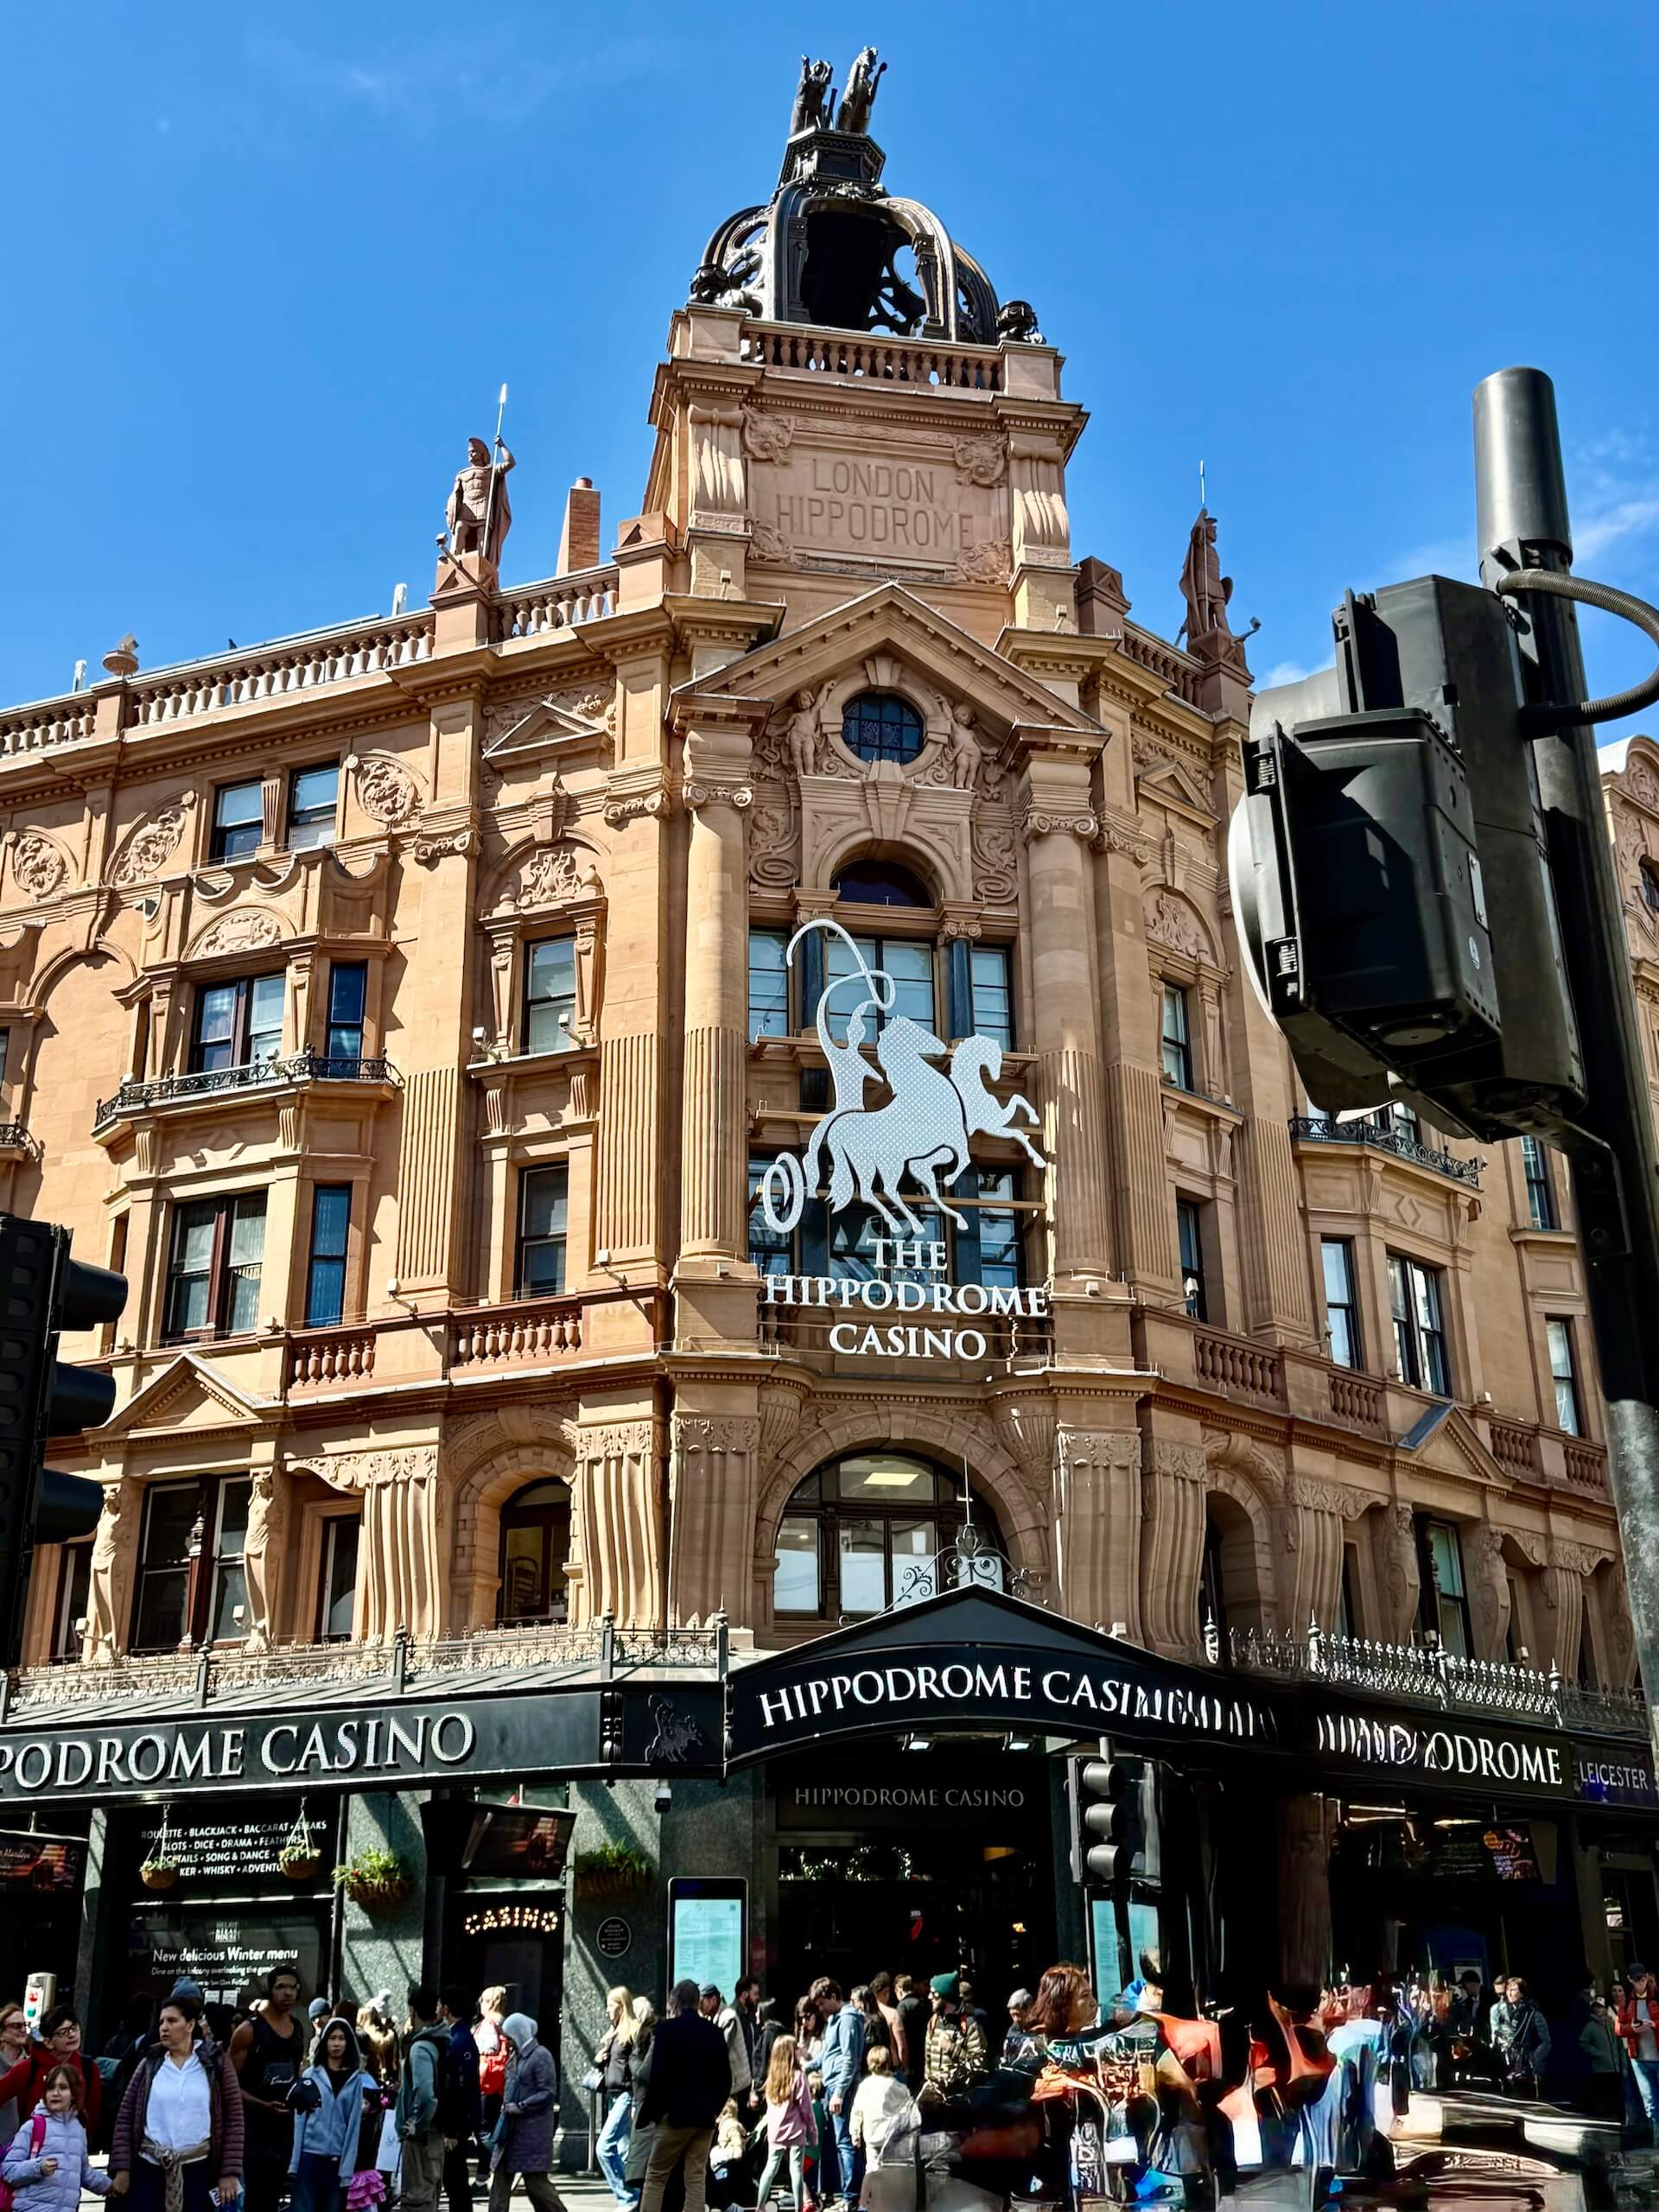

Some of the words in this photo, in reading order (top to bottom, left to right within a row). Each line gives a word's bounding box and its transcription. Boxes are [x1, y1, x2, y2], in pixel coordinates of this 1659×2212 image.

[812, 458, 935, 504] LONDON
[776, 494, 974, 550] HIPPODROME
[866, 1237, 948, 1271] THE
[763, 1274, 1048, 1318] HIPPODROME
[829, 1323, 987, 1361] CASINO
[758, 1664, 1032, 1727] HIPPODROME
[261, 1713, 475, 1775] CASINO
[1579, 1760, 1649, 1790] LEICESTER
[795, 1788, 940, 1806] HIPPODROME
[945, 1789, 1025, 1808] CASINO
[189, 1825, 238, 1838] BLACKJACK
[245, 1821, 289, 1834] BACCARAT
[194, 1840, 214, 1850] DICE
[221, 1838, 252, 1849] DRAMA
[203, 1865, 235, 1876] WHISKY
[206, 1853, 231, 1863] SONG
[232, 1851, 238, 1861] &
[239, 1850, 270, 1860] DANCE
[465, 1906, 559, 1935] CASINO
[153, 1949, 177, 1963] New
[179, 1948, 225, 1962] delicious
[226, 1946, 265, 1961] Winter
[266, 1948, 299, 1960] menu
